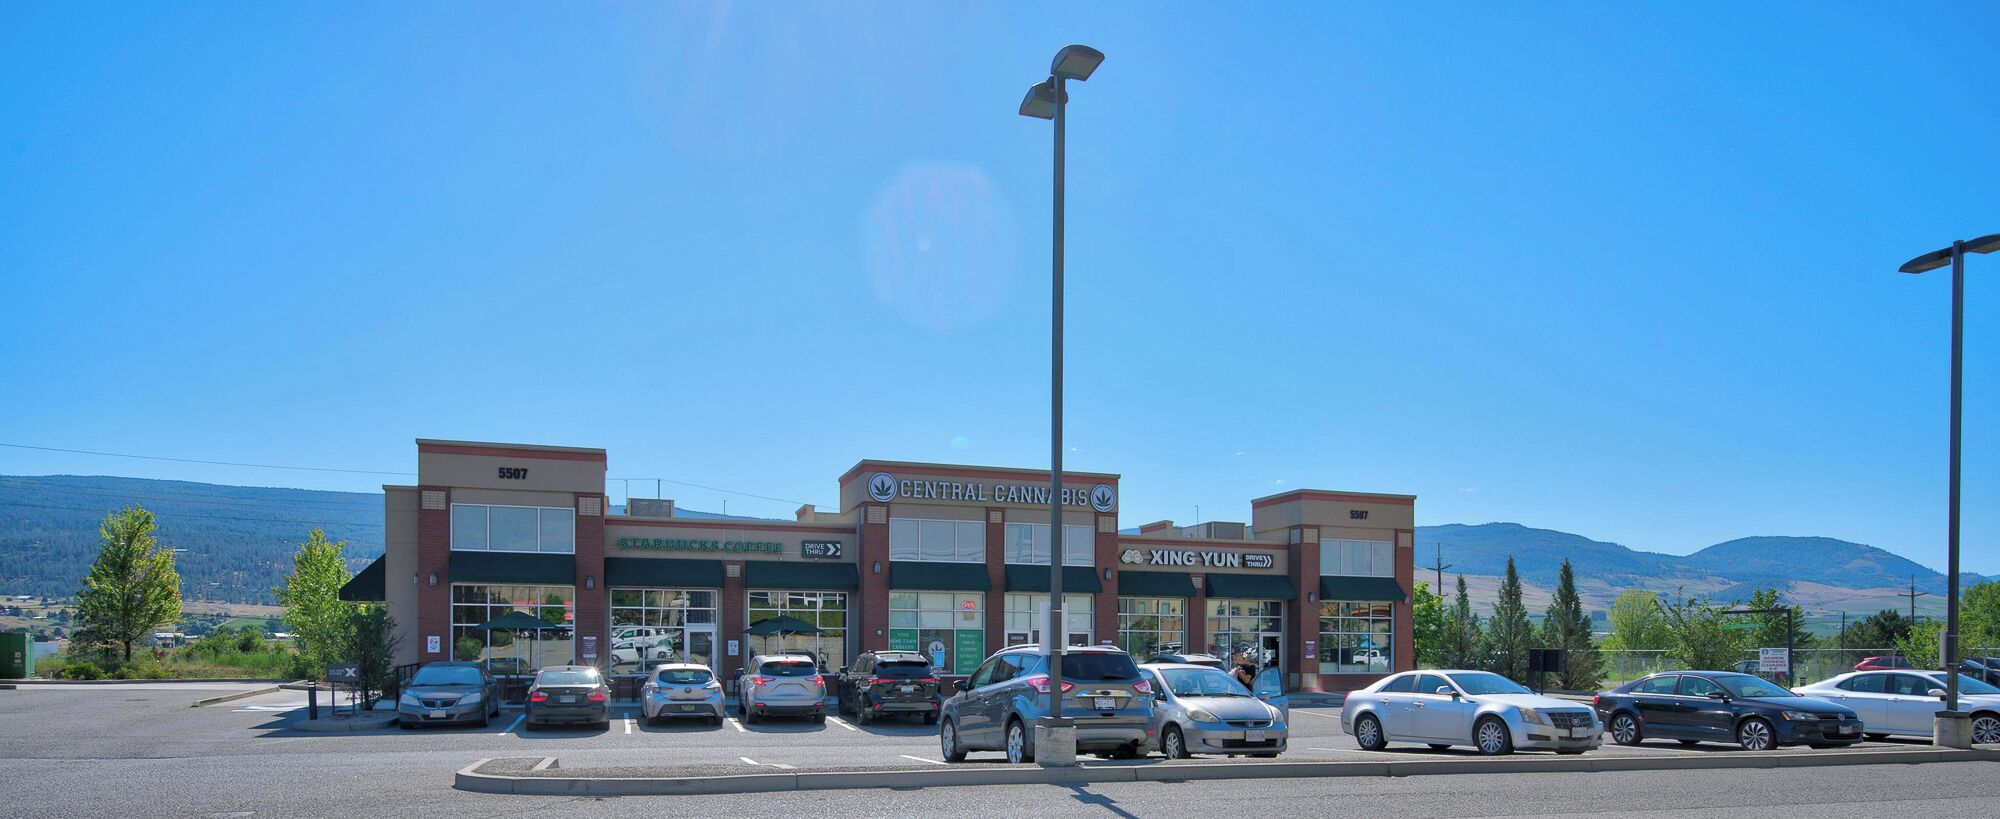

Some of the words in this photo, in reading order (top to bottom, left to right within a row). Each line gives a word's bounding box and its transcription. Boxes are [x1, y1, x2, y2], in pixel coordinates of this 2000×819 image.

[498, 467, 528, 480] 5507
[900, 479, 987, 502] CENTRAL
[1350, 510, 1368, 519] 5507
[619, 537, 720, 552] STARBUCKS
[722, 541, 784, 553] COFFEE
[1150, 549, 1196, 566] XING
[1200, 551, 1239, 567] YUN
